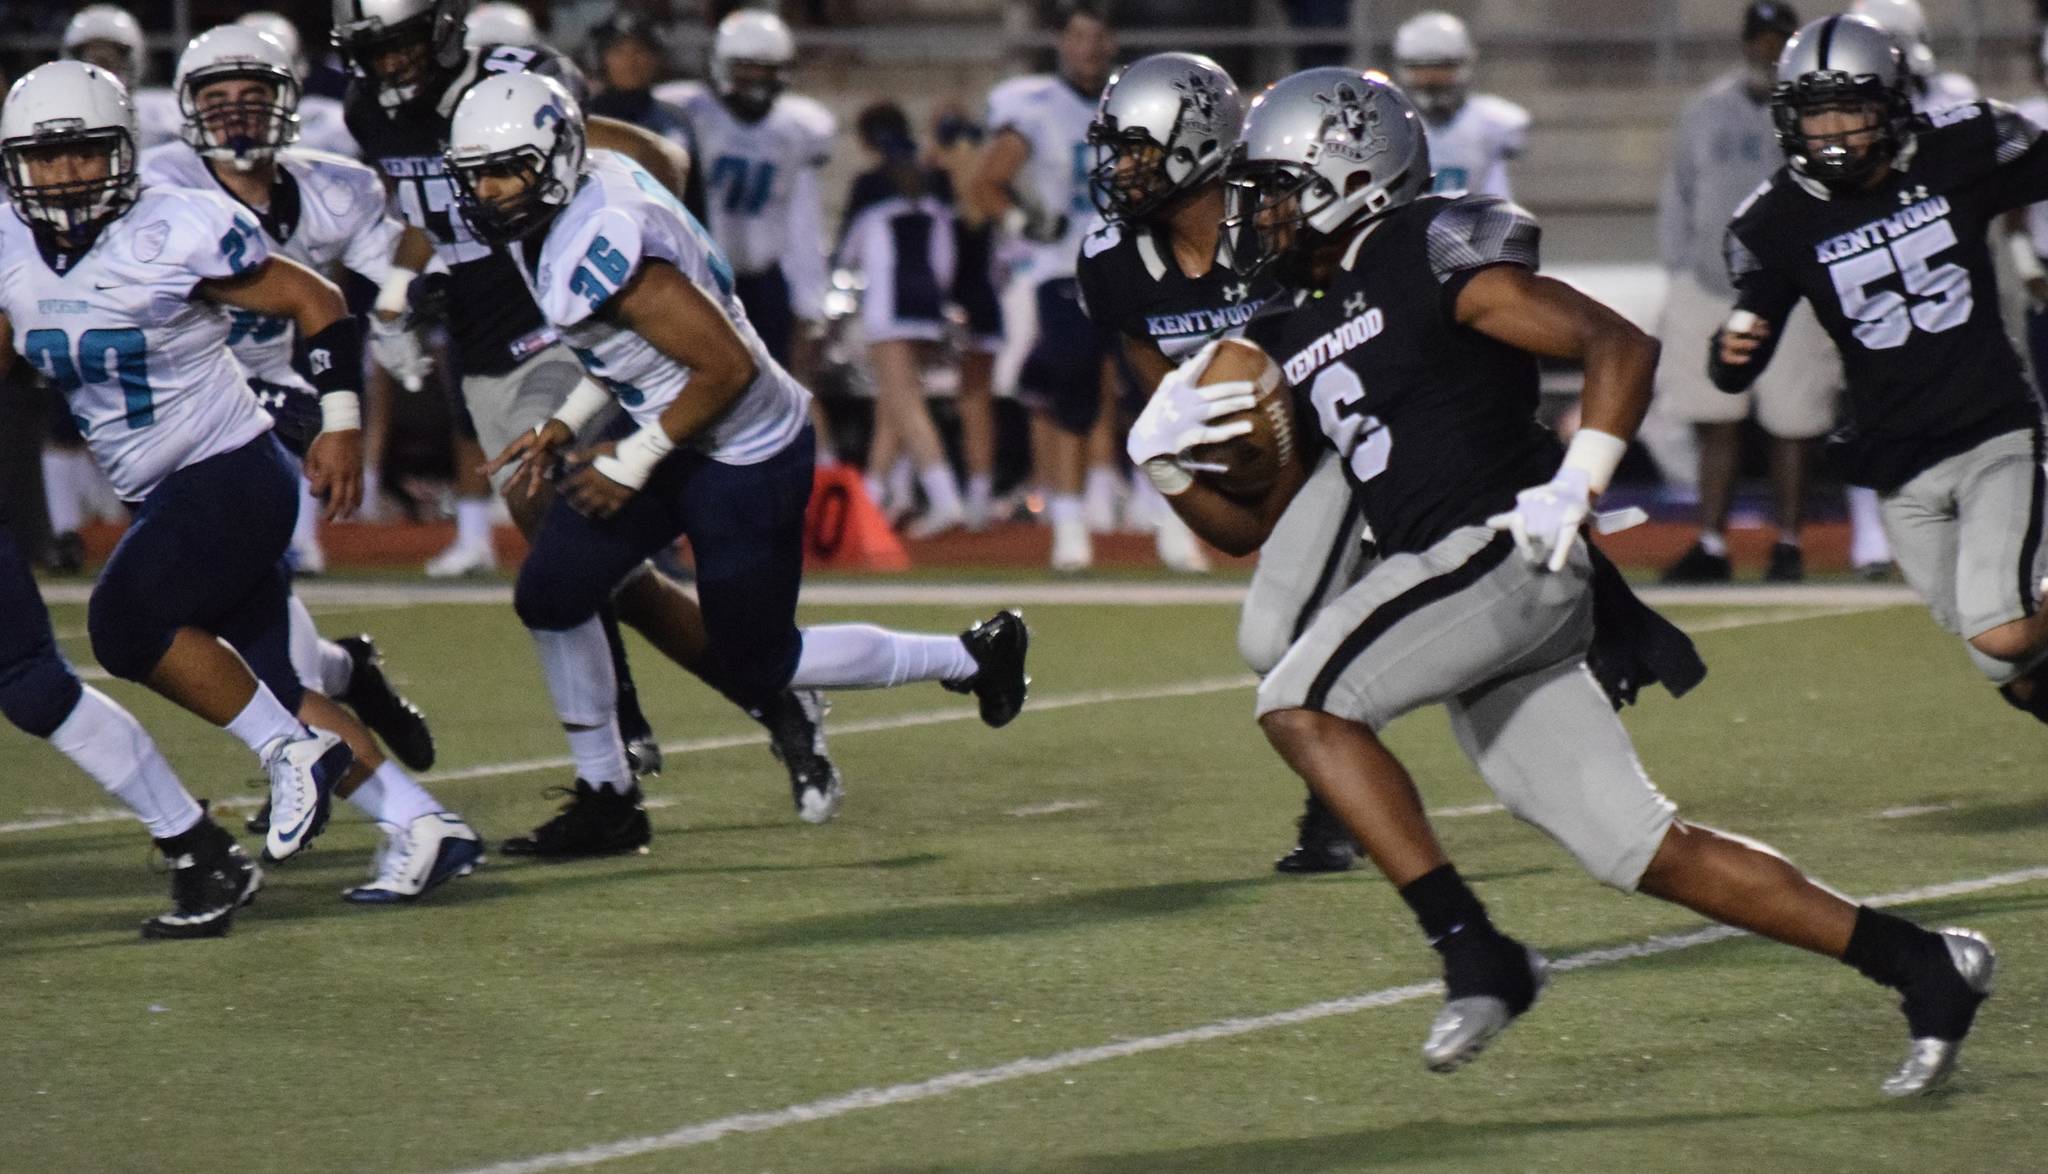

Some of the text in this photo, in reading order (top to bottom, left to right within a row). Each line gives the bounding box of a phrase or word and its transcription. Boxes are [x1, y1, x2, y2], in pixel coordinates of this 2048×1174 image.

[1815, 195, 1952, 264] KENTWOOD
[569, 235, 630, 313] 36
[1828, 218, 1975, 350] 55
[1282, 306, 1385, 386] KENTWOOD
[1309, 360, 1393, 483] 6
